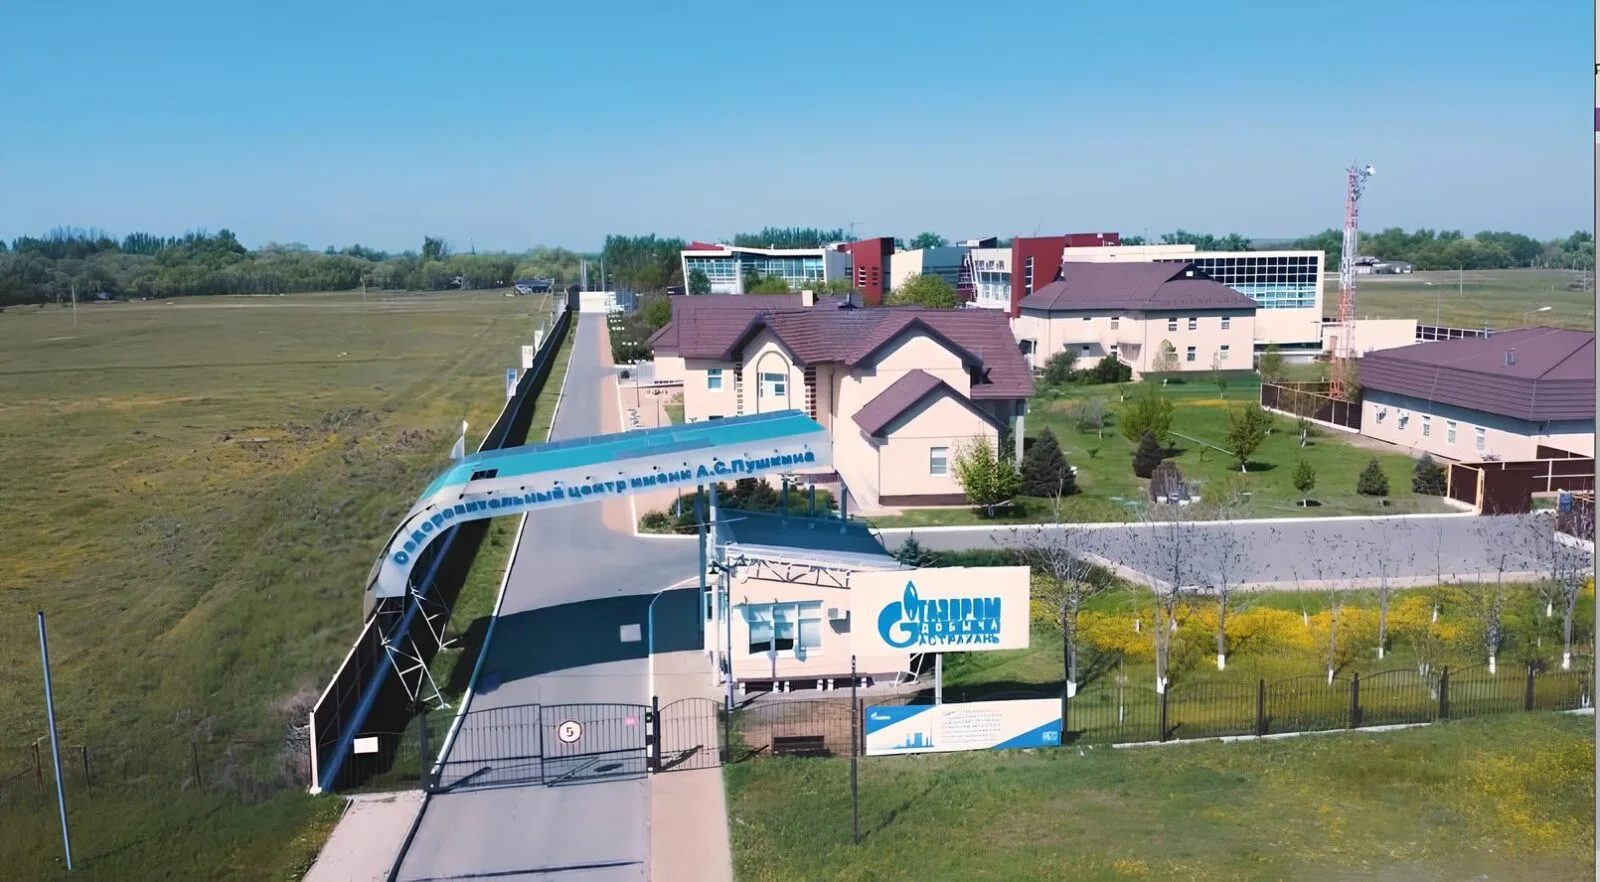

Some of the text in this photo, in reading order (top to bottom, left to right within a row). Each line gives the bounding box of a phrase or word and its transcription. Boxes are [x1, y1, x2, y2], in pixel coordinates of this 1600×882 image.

[393, 486, 565, 565] Оздоровительный
[568, 480, 627, 498] центр
[631, 469, 692, 488] имени
[918, 597, 1001, 621] ГАЗПРОМ
[921, 620, 998, 634] ДОБЫЧА
[919, 633, 1000, 646] АСТРАХАНЬ
[566, 727, 574, 737] 5
